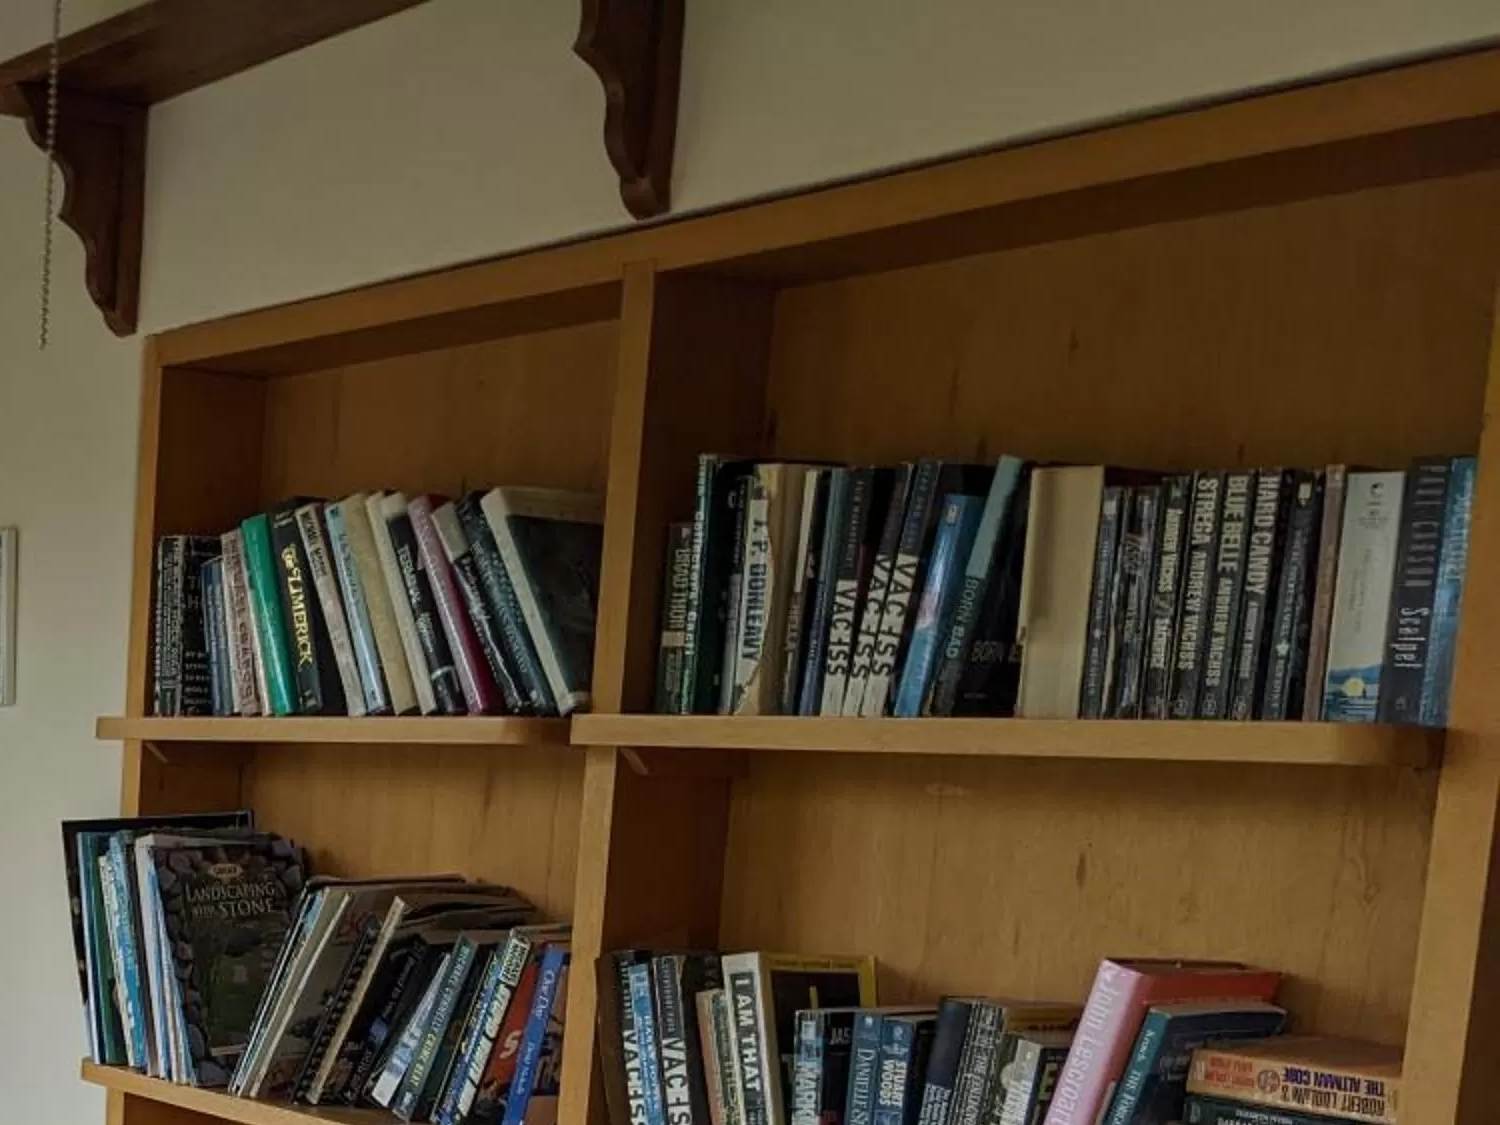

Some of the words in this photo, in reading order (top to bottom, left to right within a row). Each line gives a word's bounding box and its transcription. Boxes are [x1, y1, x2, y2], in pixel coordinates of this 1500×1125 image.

[1191, 478, 1218, 545] STREGA
[1224, 475, 1247, 519] BLUE
[1253, 475, 1279, 527] HARD
[1218, 522, 1241, 572] BELLE
[1245, 532, 1272, 595] CANDY
[956, 579, 978, 623] BORN
[1185, 551, 1207, 611] ANDREW
[287, 569, 312, 671] LIMERICK
[742, 563, 766, 662] DONLEAVY
[871, 562, 918, 678] VACHSS
[1214, 577, 1232, 635] ANDREW
[946, 625, 964, 659] BAD
[1178, 615, 1199, 671] VACHSS
[1205, 636, 1224, 687] VACHSS
[1390, 607, 1429, 669] Scalpel
[185, 882, 274, 901] LANDSCAPING
[219, 899, 274, 917] STONE
[540, 969, 556, 993] One
[533, 995, 549, 1021] Day
[737, 994, 753, 1027] AM
[1087, 985, 1122, 1030] John
[421, 1033, 438, 1062] CRIME
[741, 1034, 760, 1091] THAT
[410, 1063, 427, 1088] BEAT
[853, 1048, 875, 1106] DANIELLE
[880, 1059, 894, 1106] WOODS
[893, 1059, 907, 1107] STUART
[1313, 1073, 1362, 1093] ALTMAN
[1364, 1080, 1385, 1097] THE
[1341, 1093, 1385, 1117] ROBERT
